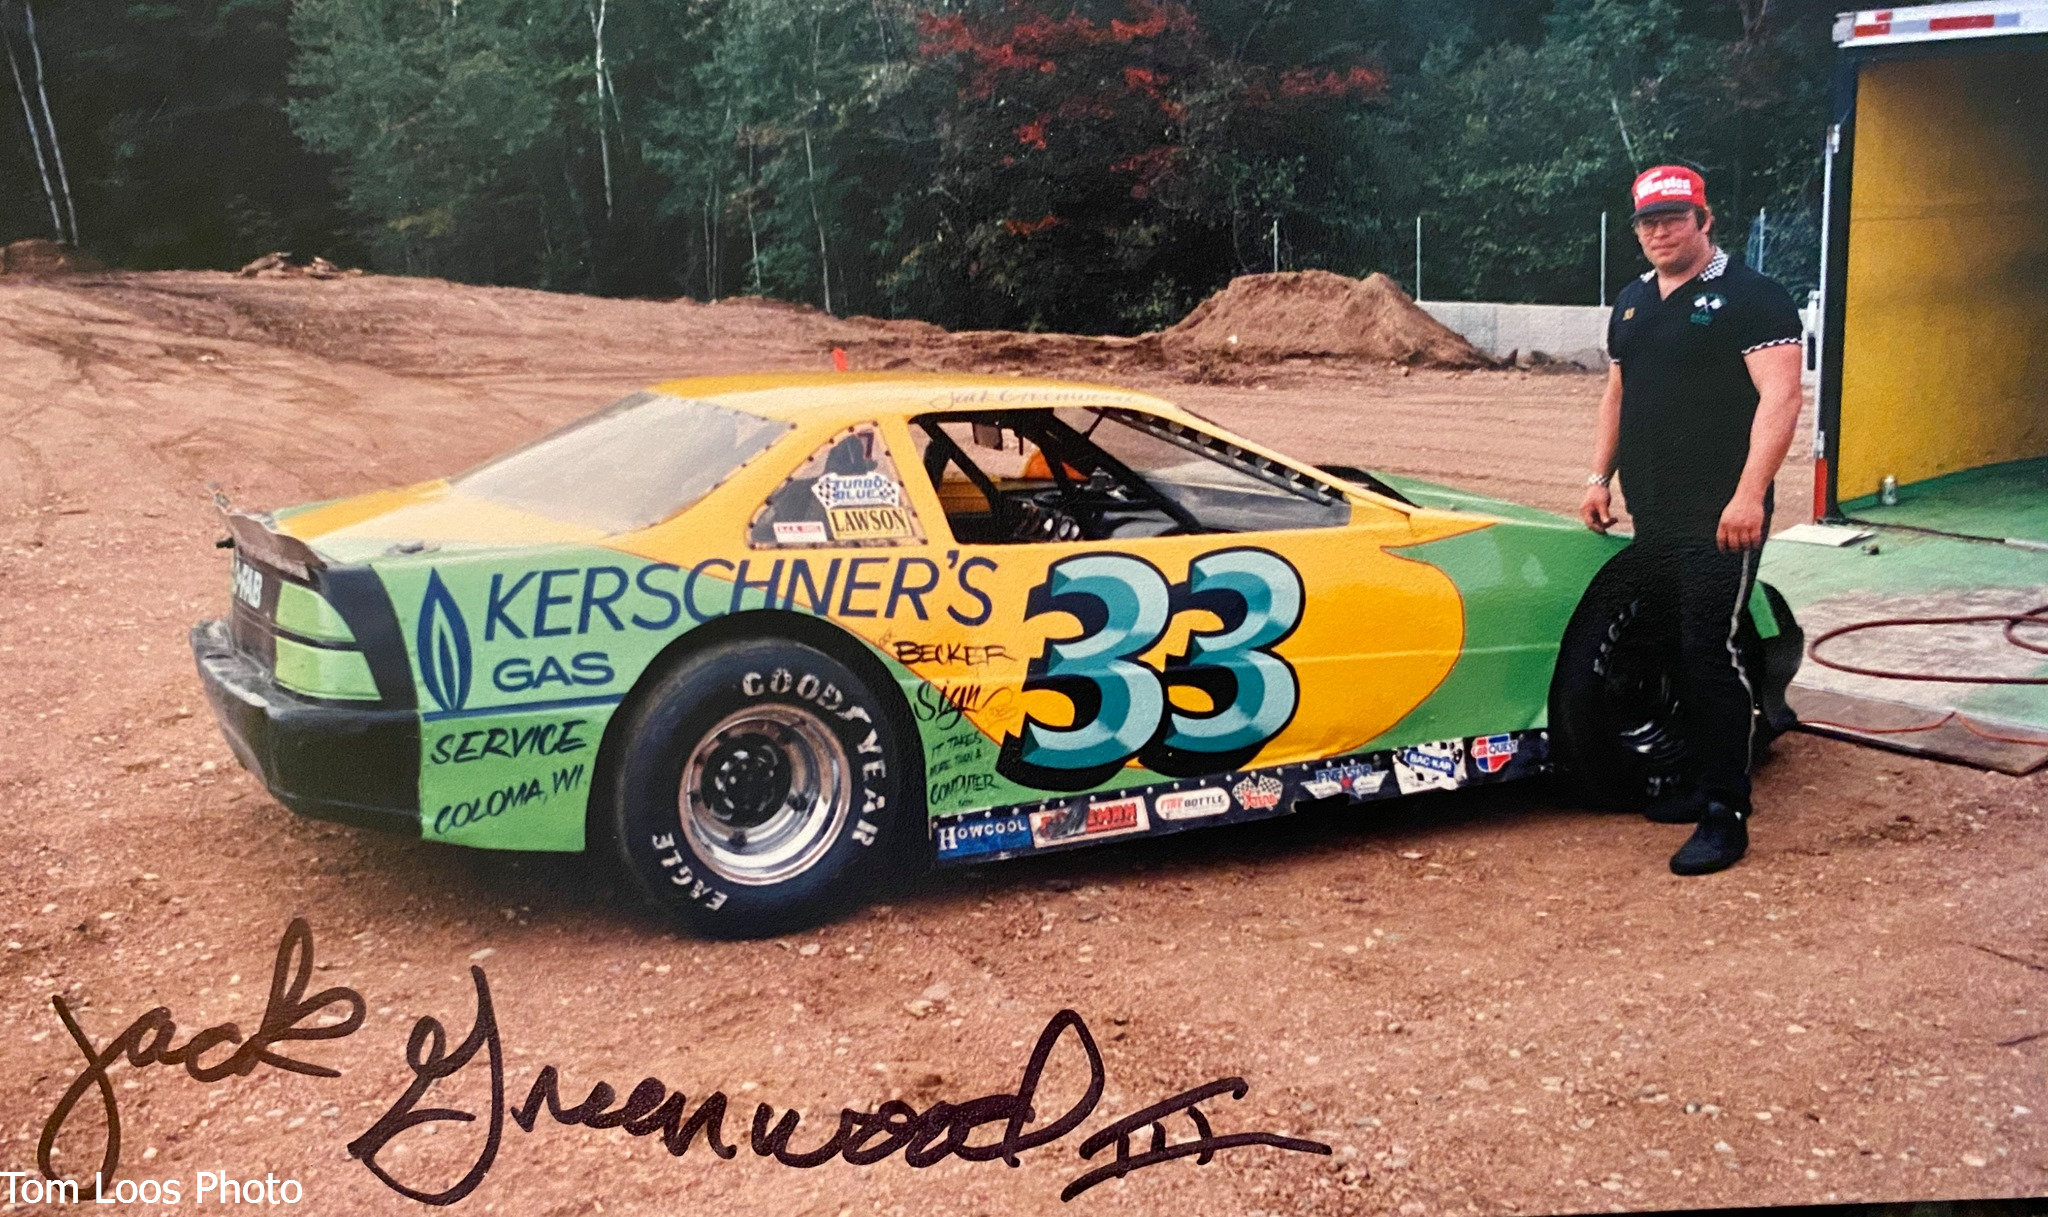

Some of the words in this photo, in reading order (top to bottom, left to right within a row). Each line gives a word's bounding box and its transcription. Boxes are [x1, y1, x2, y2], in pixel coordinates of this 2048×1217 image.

[831, 509, 906, 533] LAWSON
[484, 548, 999, 642] KERSCHNER'S
[493, 651, 615, 693] GAS
[893, 641, 1018, 666] BECKER
[997, 546, 1306, 790] 33
[430, 720, 587, 765] SERVICE
[742, 667, 886, 847] GOODYEAR
[434, 778, 549, 835] COLOMA,
[651, 832, 728, 911] EAGLE
[347, 965, 1107, 1206] Greenwood
